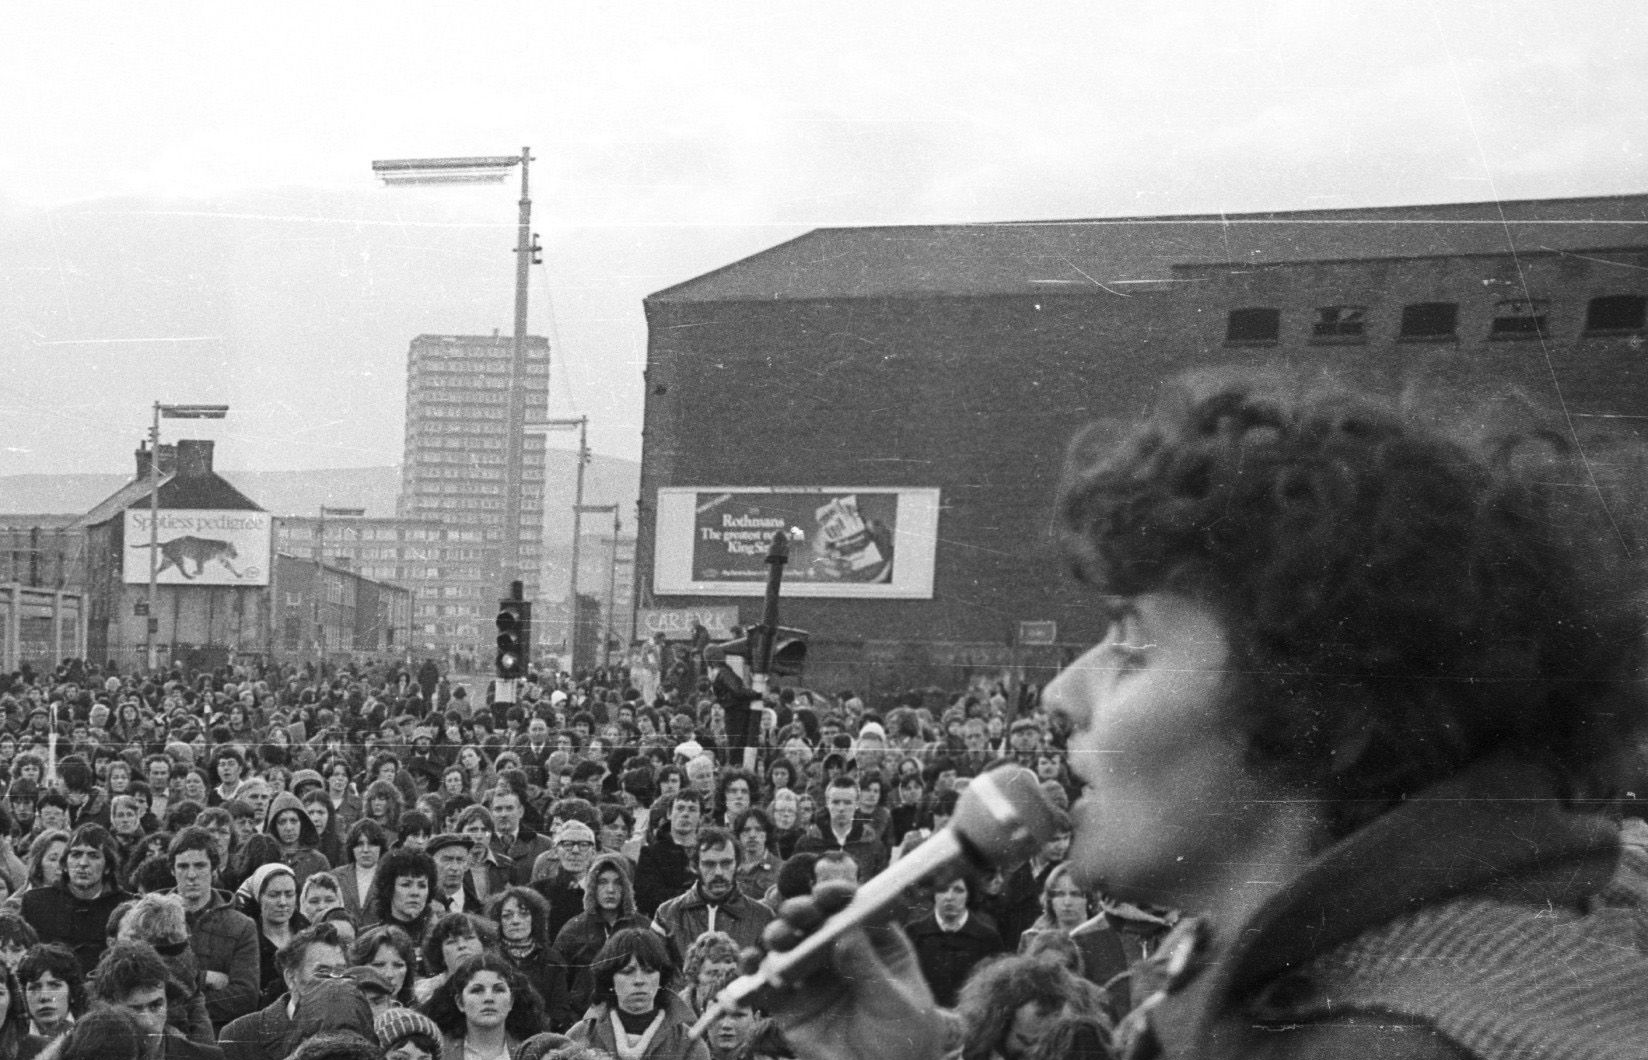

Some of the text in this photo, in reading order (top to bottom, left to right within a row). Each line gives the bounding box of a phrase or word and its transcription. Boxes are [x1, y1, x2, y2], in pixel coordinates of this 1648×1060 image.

[722, 513, 785, 528] Rothmans
[700, 527, 721, 540] The
[723, 530, 761, 542] greatest
[645, 610, 680, 633] CAR
